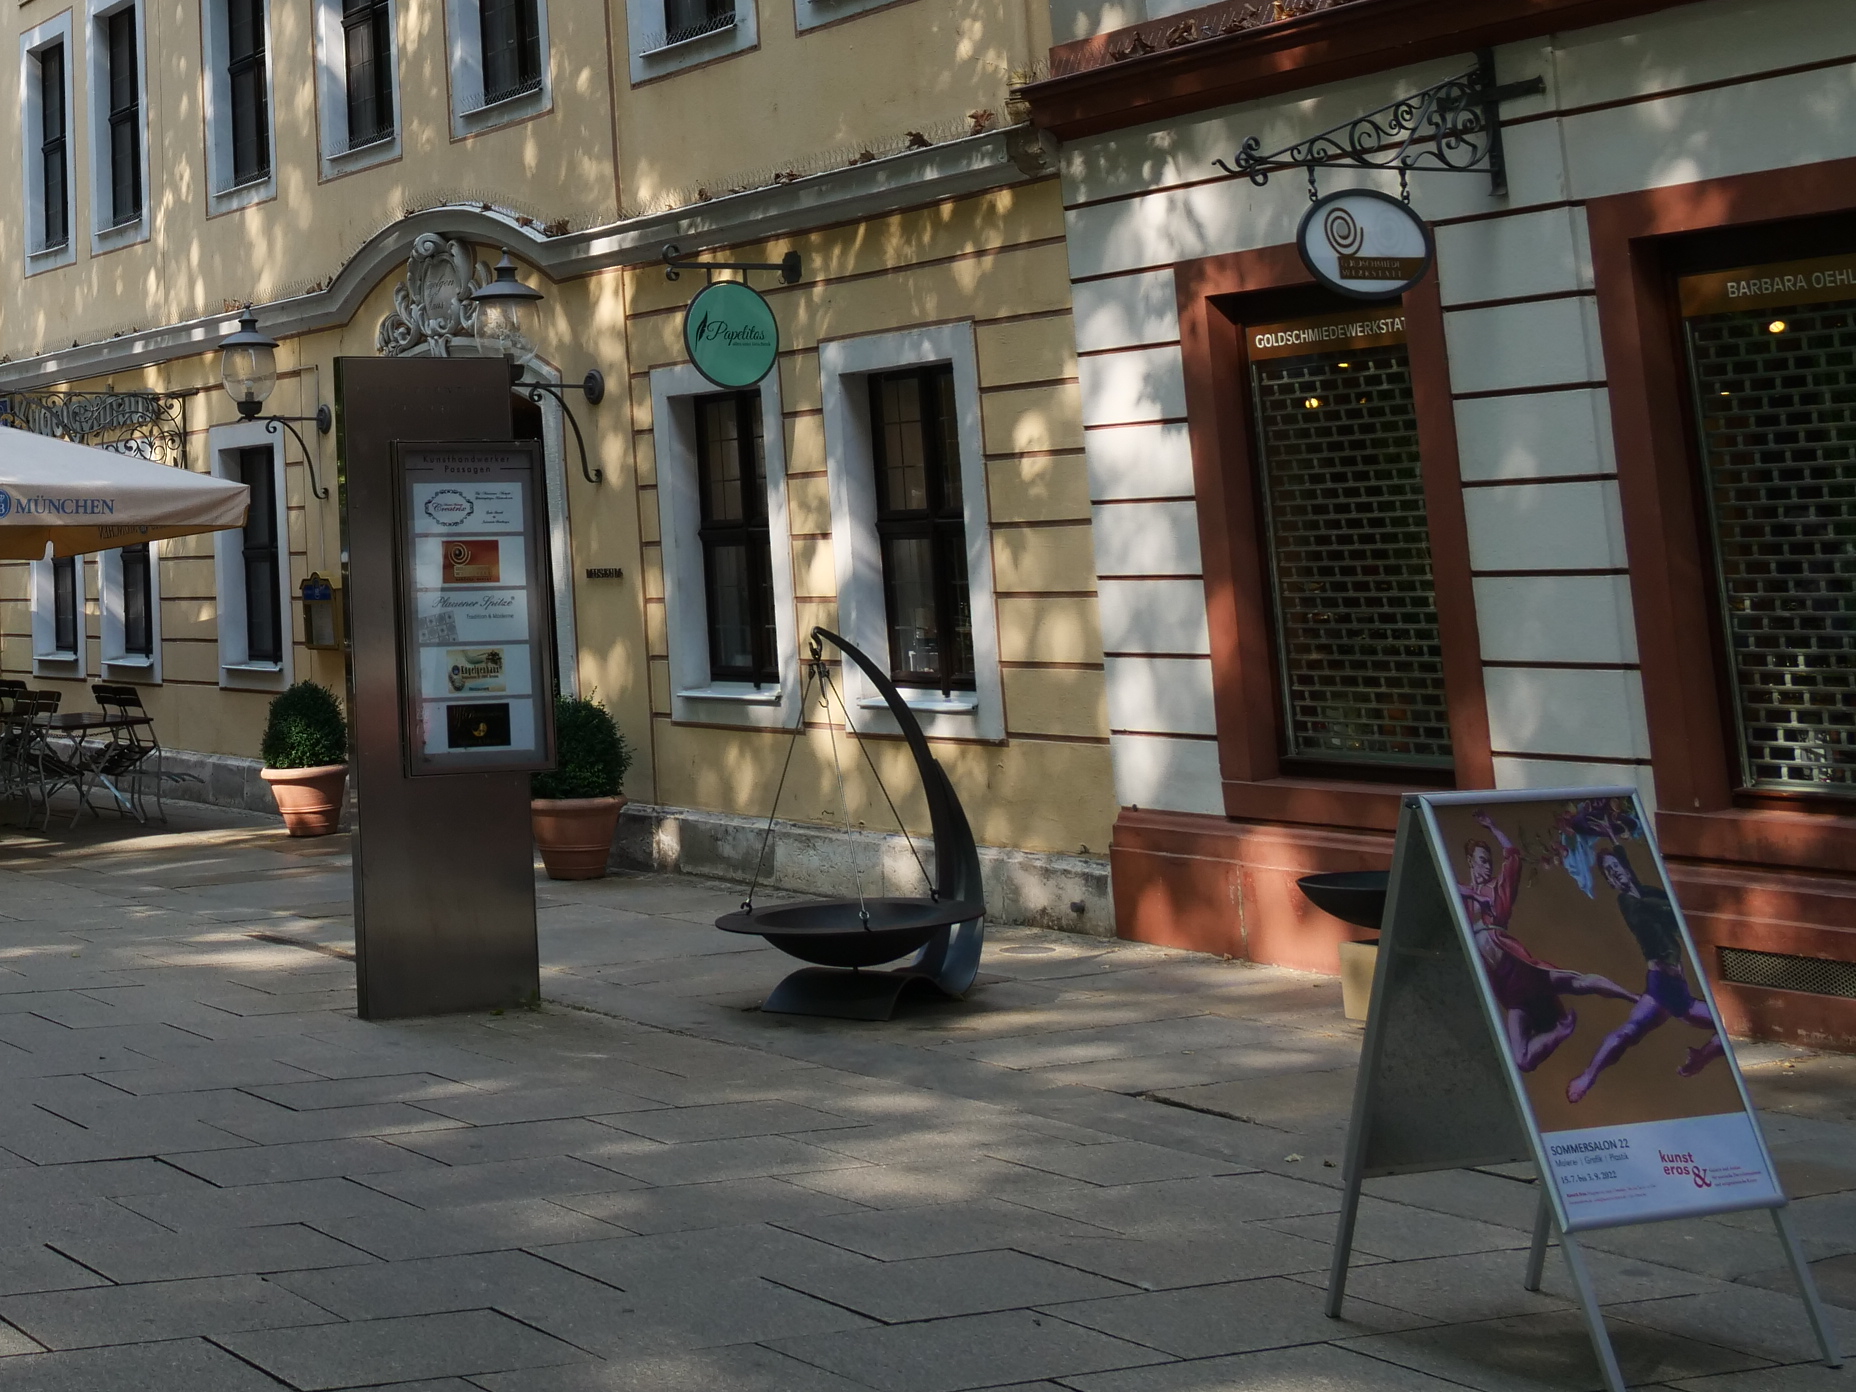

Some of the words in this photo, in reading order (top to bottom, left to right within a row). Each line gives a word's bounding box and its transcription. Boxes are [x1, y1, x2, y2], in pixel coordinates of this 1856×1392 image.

[1726, 274, 1809, 298] BARBARA
[706, 320, 765, 347] Papelitos
[423, 455, 510, 464] Kunsthandwerker
[444, 466, 491, 474] Passagen
[15, 495, 115, 515] MÜNCHEN
[432, 596, 479, 609] Plauener
[1550, 1139, 1618, 1156] SOMMERSALON
[1618, 1138, 1630, 1149] 22
[1658, 1149, 1694, 1164] kunst
[1663, 1164, 1690, 1176] eros
[1691, 1165, 1712, 1189] &
